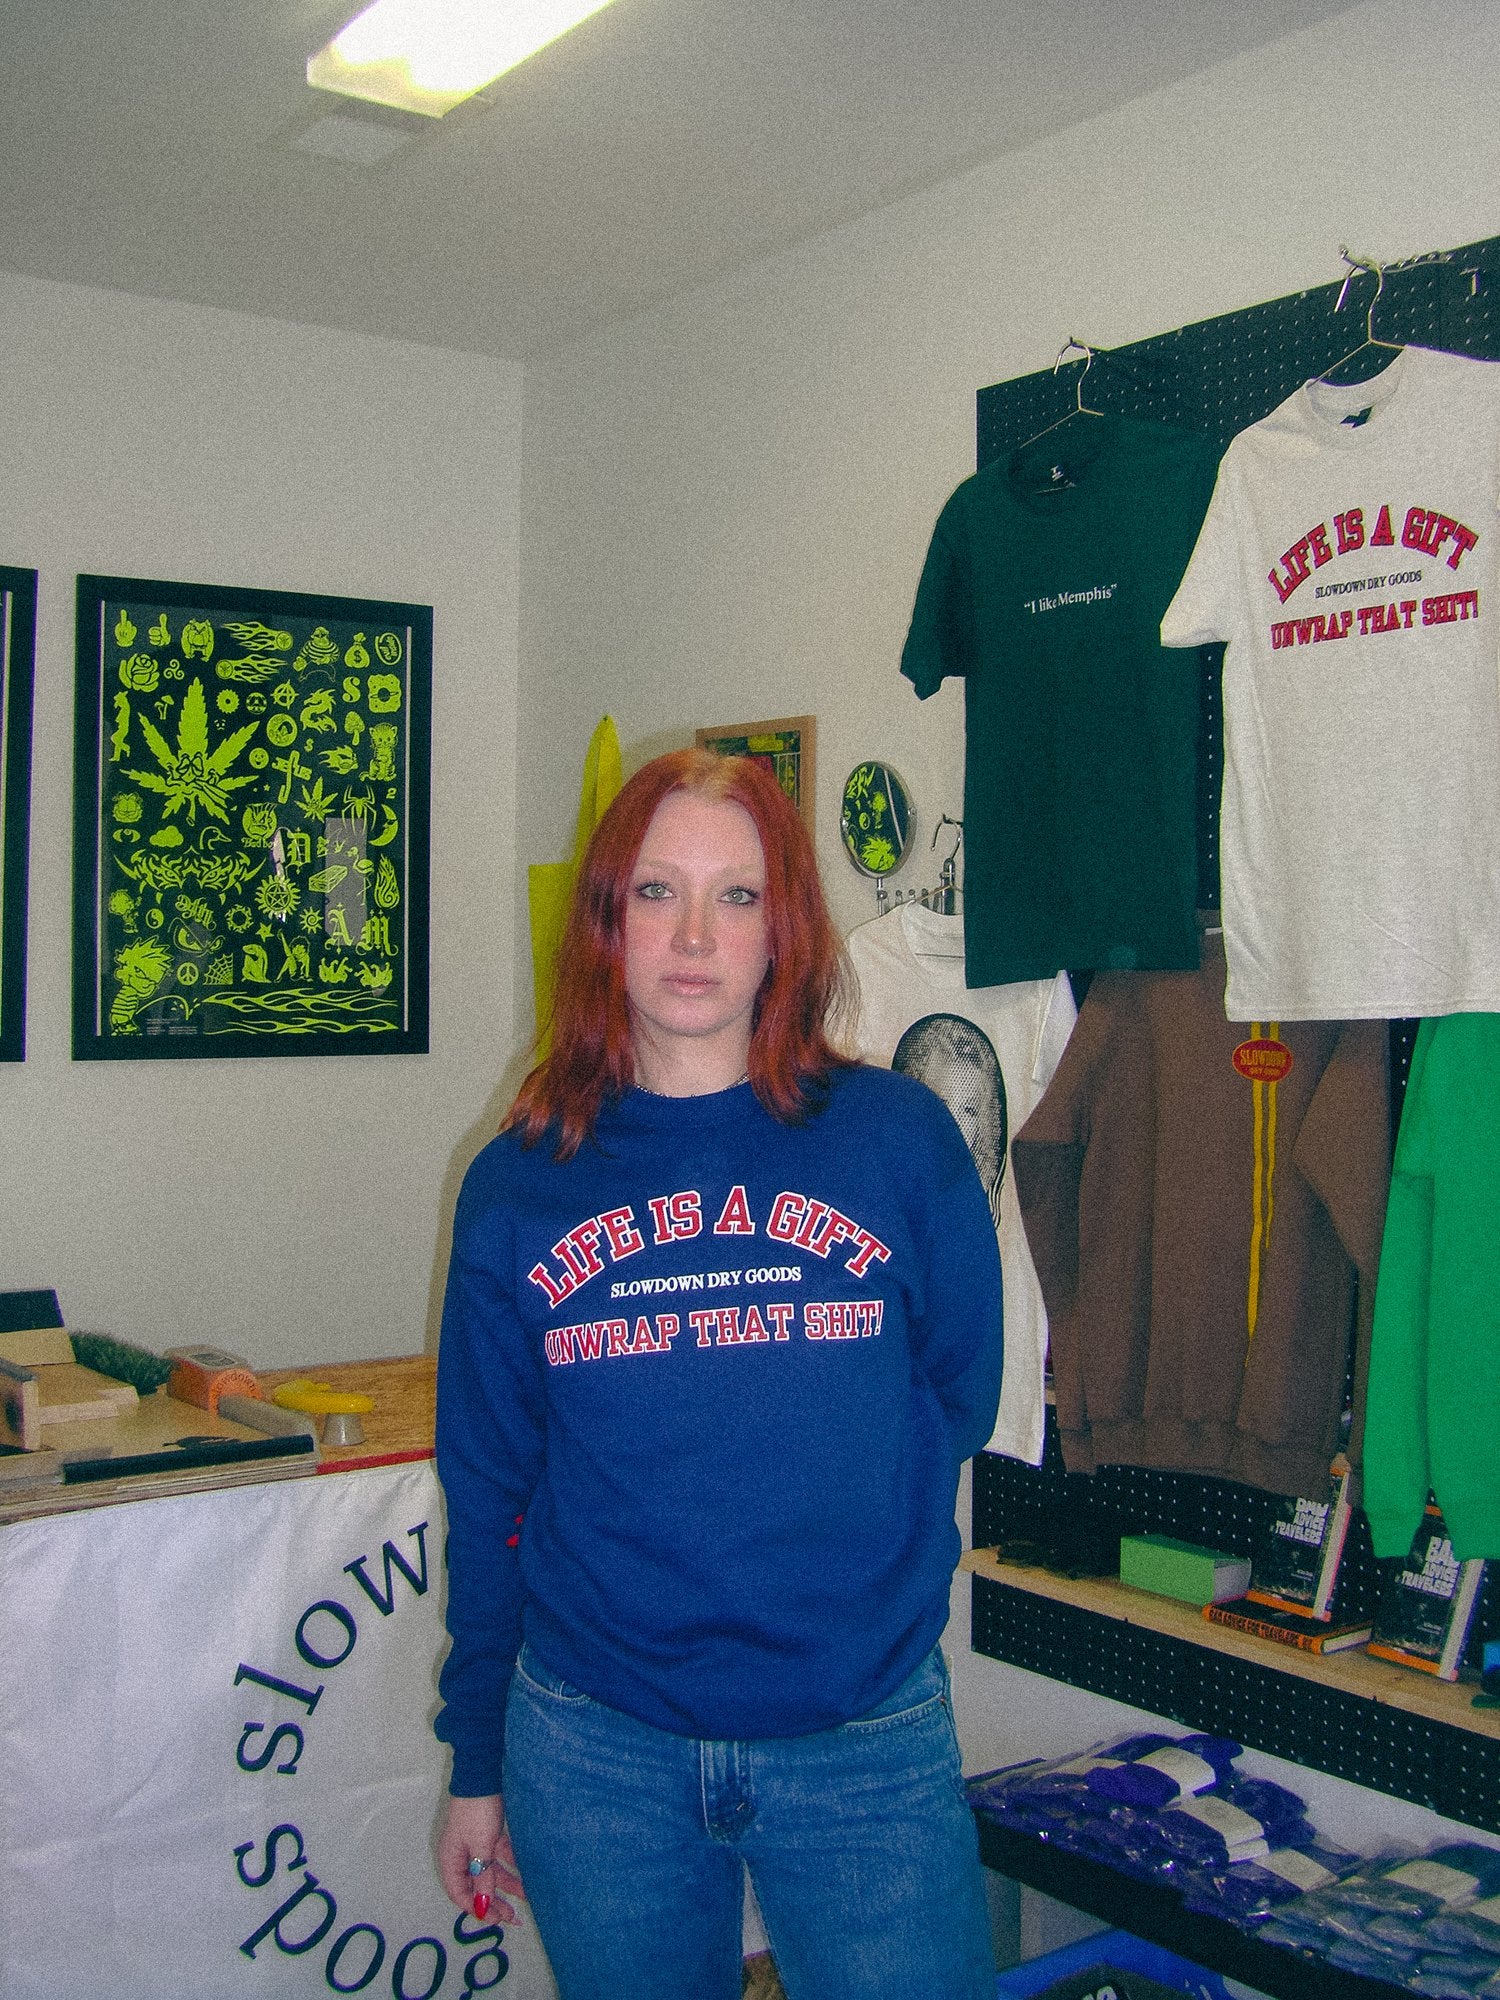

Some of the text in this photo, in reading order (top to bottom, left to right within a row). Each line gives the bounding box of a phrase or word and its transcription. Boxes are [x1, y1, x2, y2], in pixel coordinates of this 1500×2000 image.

[1268, 504, 1479, 604] LIFE IS A GIFT
[1315, 570, 1422, 599] SLOWDOWN DRY GOODS
[1039, 597, 1057, 612] like
[1270, 590, 1479, 650] UNWRAP THAT SHIT!
[527, 1185, 892, 1309] LIFE IS A GIFT
[610, 1266, 801, 1298] SLOWDOWN DRY GOODS
[544, 1300, 884, 1367] UNWRAP THAT SHIT!
[1275, 1520, 1322, 1545] TRAVELERS
[1293, 1511, 1326, 1533] ADVICE
[1401, 1570, 1455, 1597] TRAVELERS
[1421, 1561, 1459, 1583] ADVICE
[232, 1520, 510, 2000] slow goods
